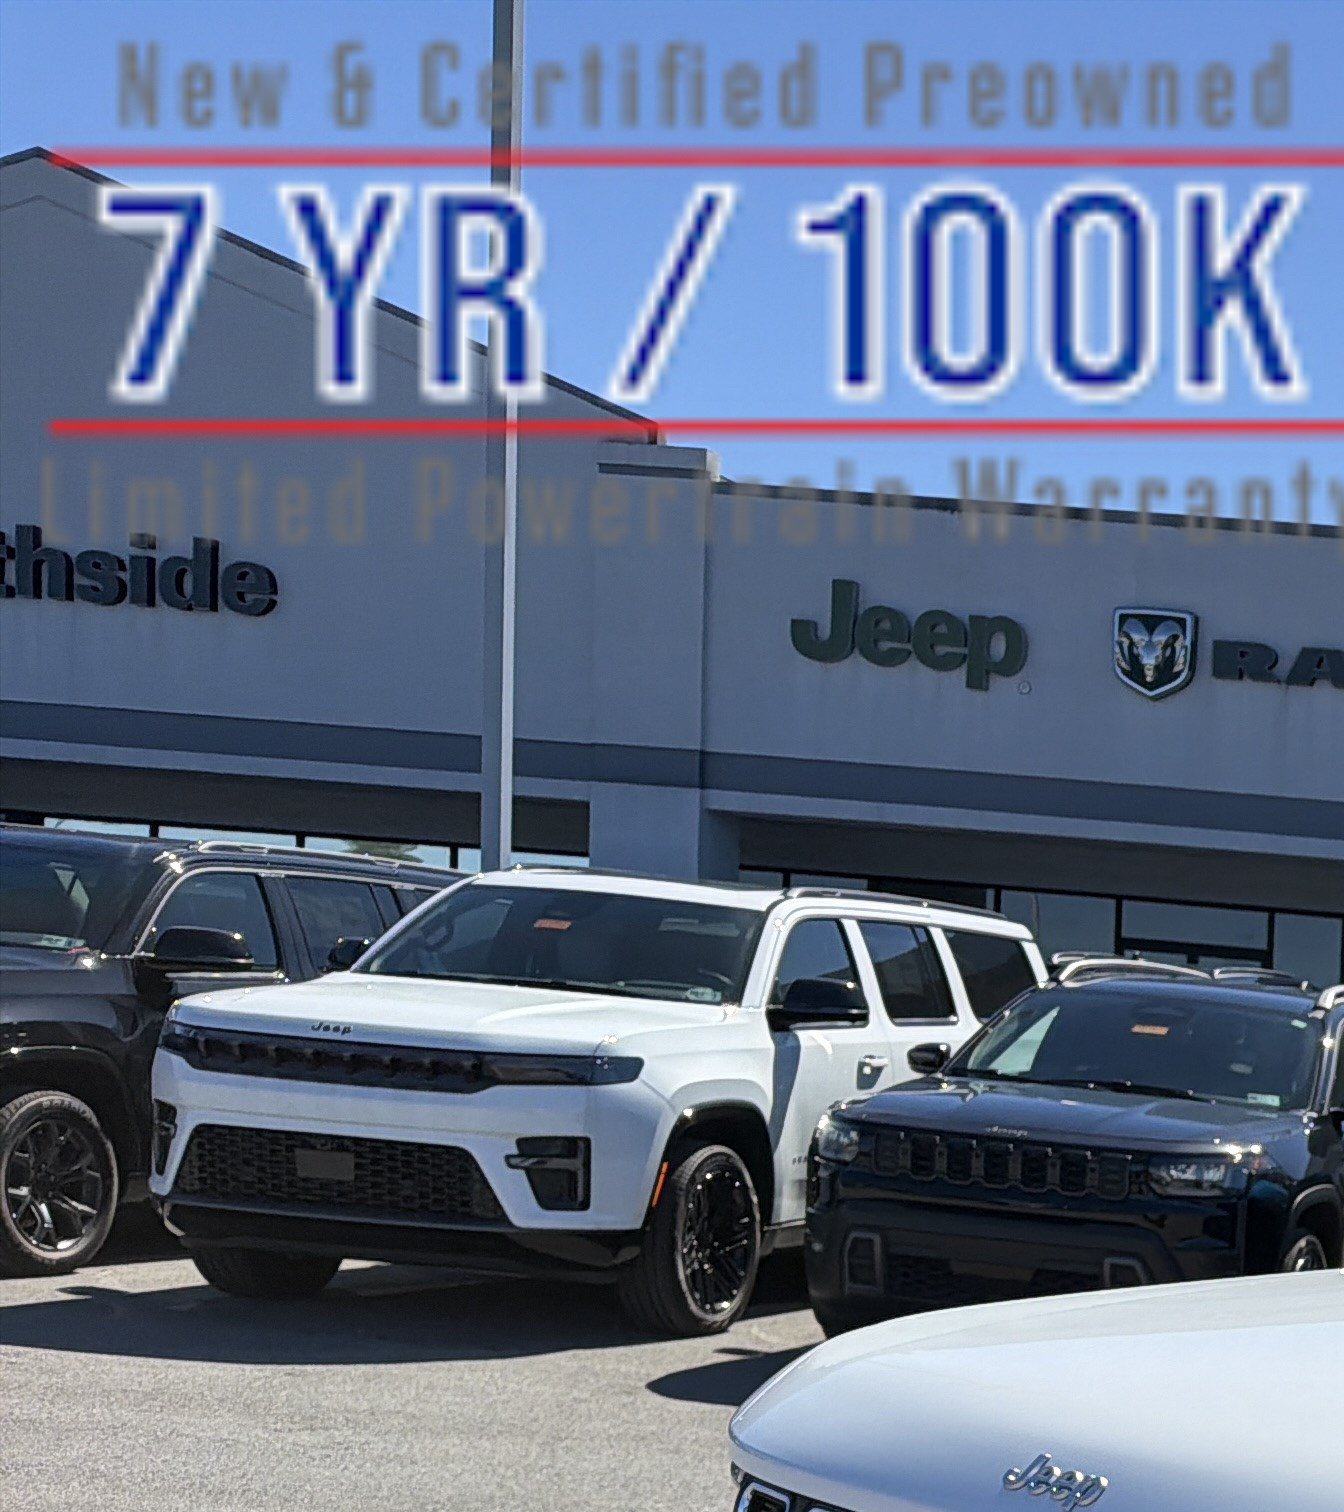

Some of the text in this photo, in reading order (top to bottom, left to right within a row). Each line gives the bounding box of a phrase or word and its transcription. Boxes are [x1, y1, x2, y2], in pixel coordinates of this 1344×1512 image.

[790, 578, 1029, 692] Jeep
[311, 1021, 353, 1036] Jeep
[1003, 1453, 1109, 1512] Jeep
